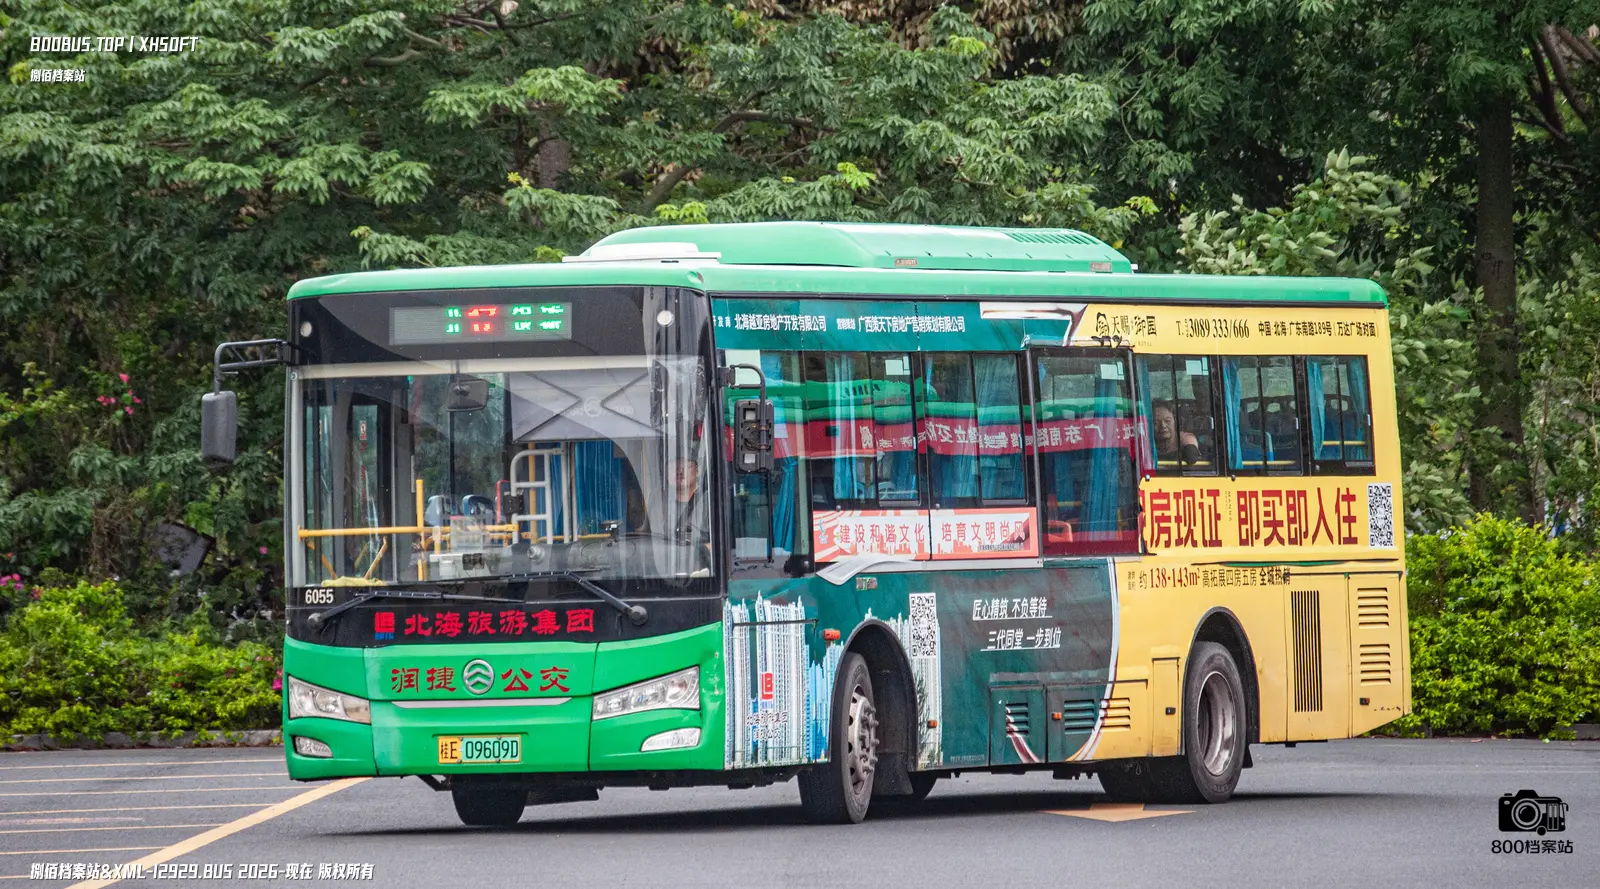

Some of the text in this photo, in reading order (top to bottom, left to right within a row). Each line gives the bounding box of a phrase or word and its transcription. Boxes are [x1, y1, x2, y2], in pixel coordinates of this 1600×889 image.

[734, 314, 827, 332] 北海越亚房地产开发有限公司
[1212, 318, 1250, 338] 333/666
[1236, 487, 1358, 547] 即买即入住
[839, 523, 925, 544] 建设和谐文化
[305, 589, 334, 605] 6055
[972, 597, 1047, 620] 匠心精筑 不负等待
[404, 609, 595, 636] 北海旅游集团
[988, 627, 1062, 649] 三代同堂 一步到位
[391, 666, 570, 693] 润捷 公交
[465, 740, 519, 760] 09609D
